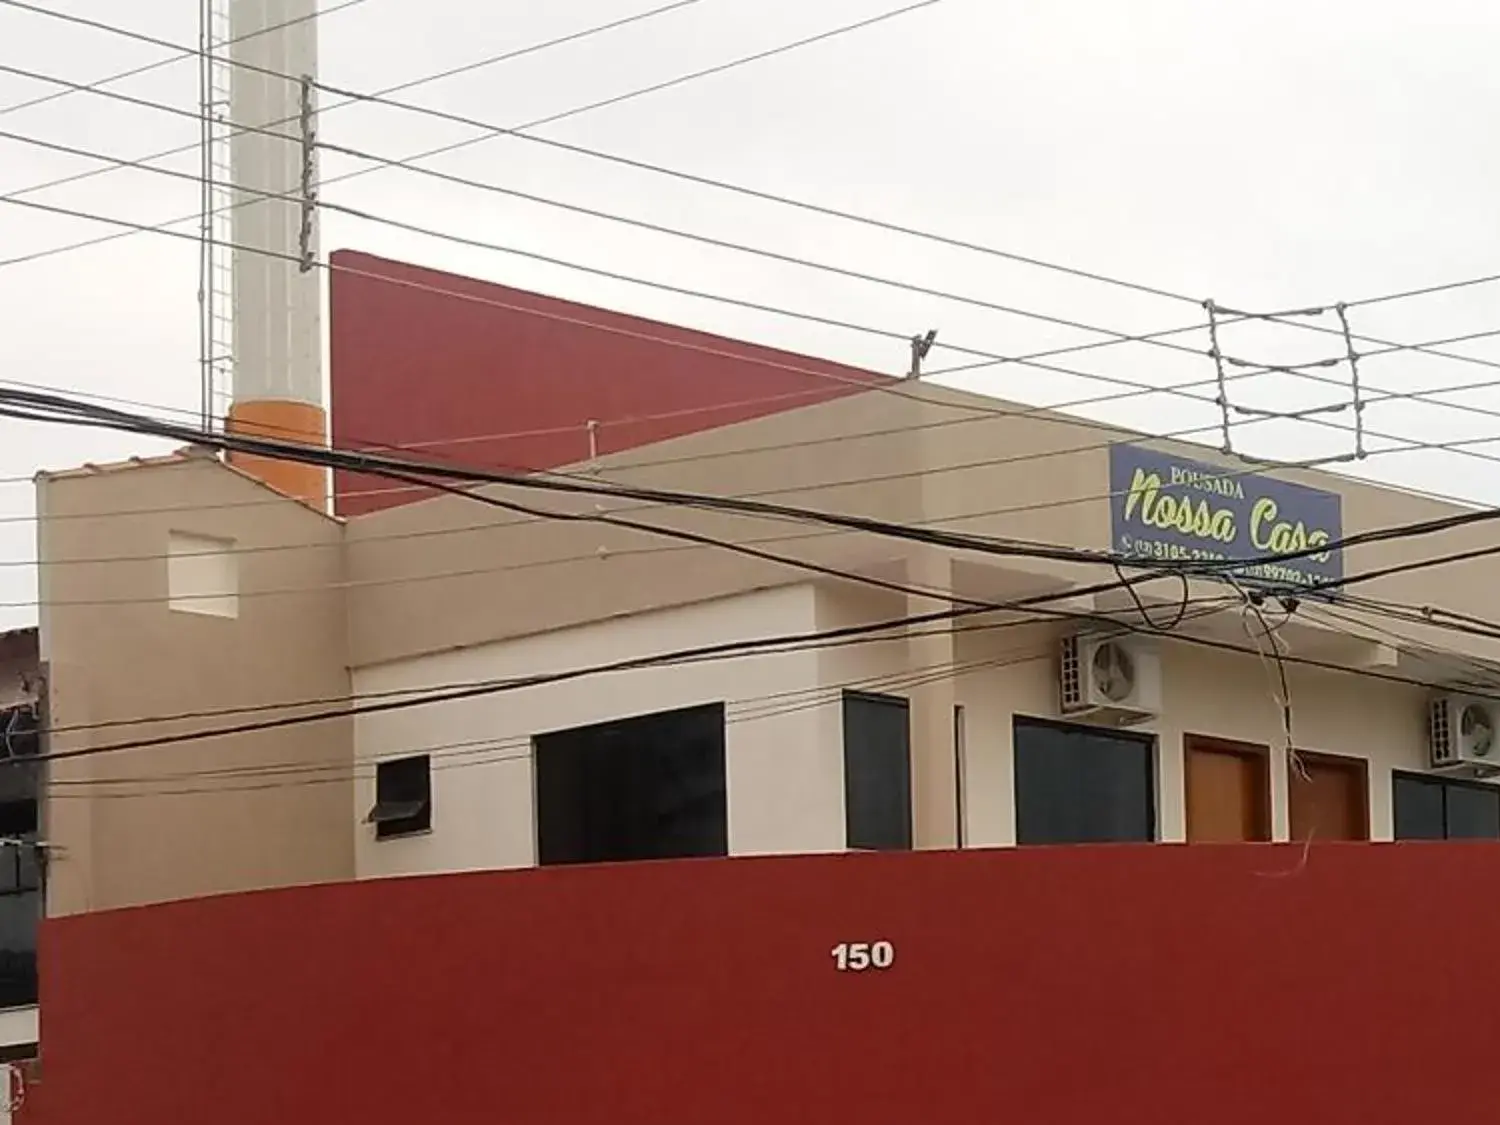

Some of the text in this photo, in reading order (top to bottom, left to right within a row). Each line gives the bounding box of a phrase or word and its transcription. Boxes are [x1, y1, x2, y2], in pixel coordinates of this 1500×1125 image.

[1170, 465, 1244, 499] POUSADA
[1125, 467, 1329, 563] Nossa Casa
[831, 941, 894, 970] 150
